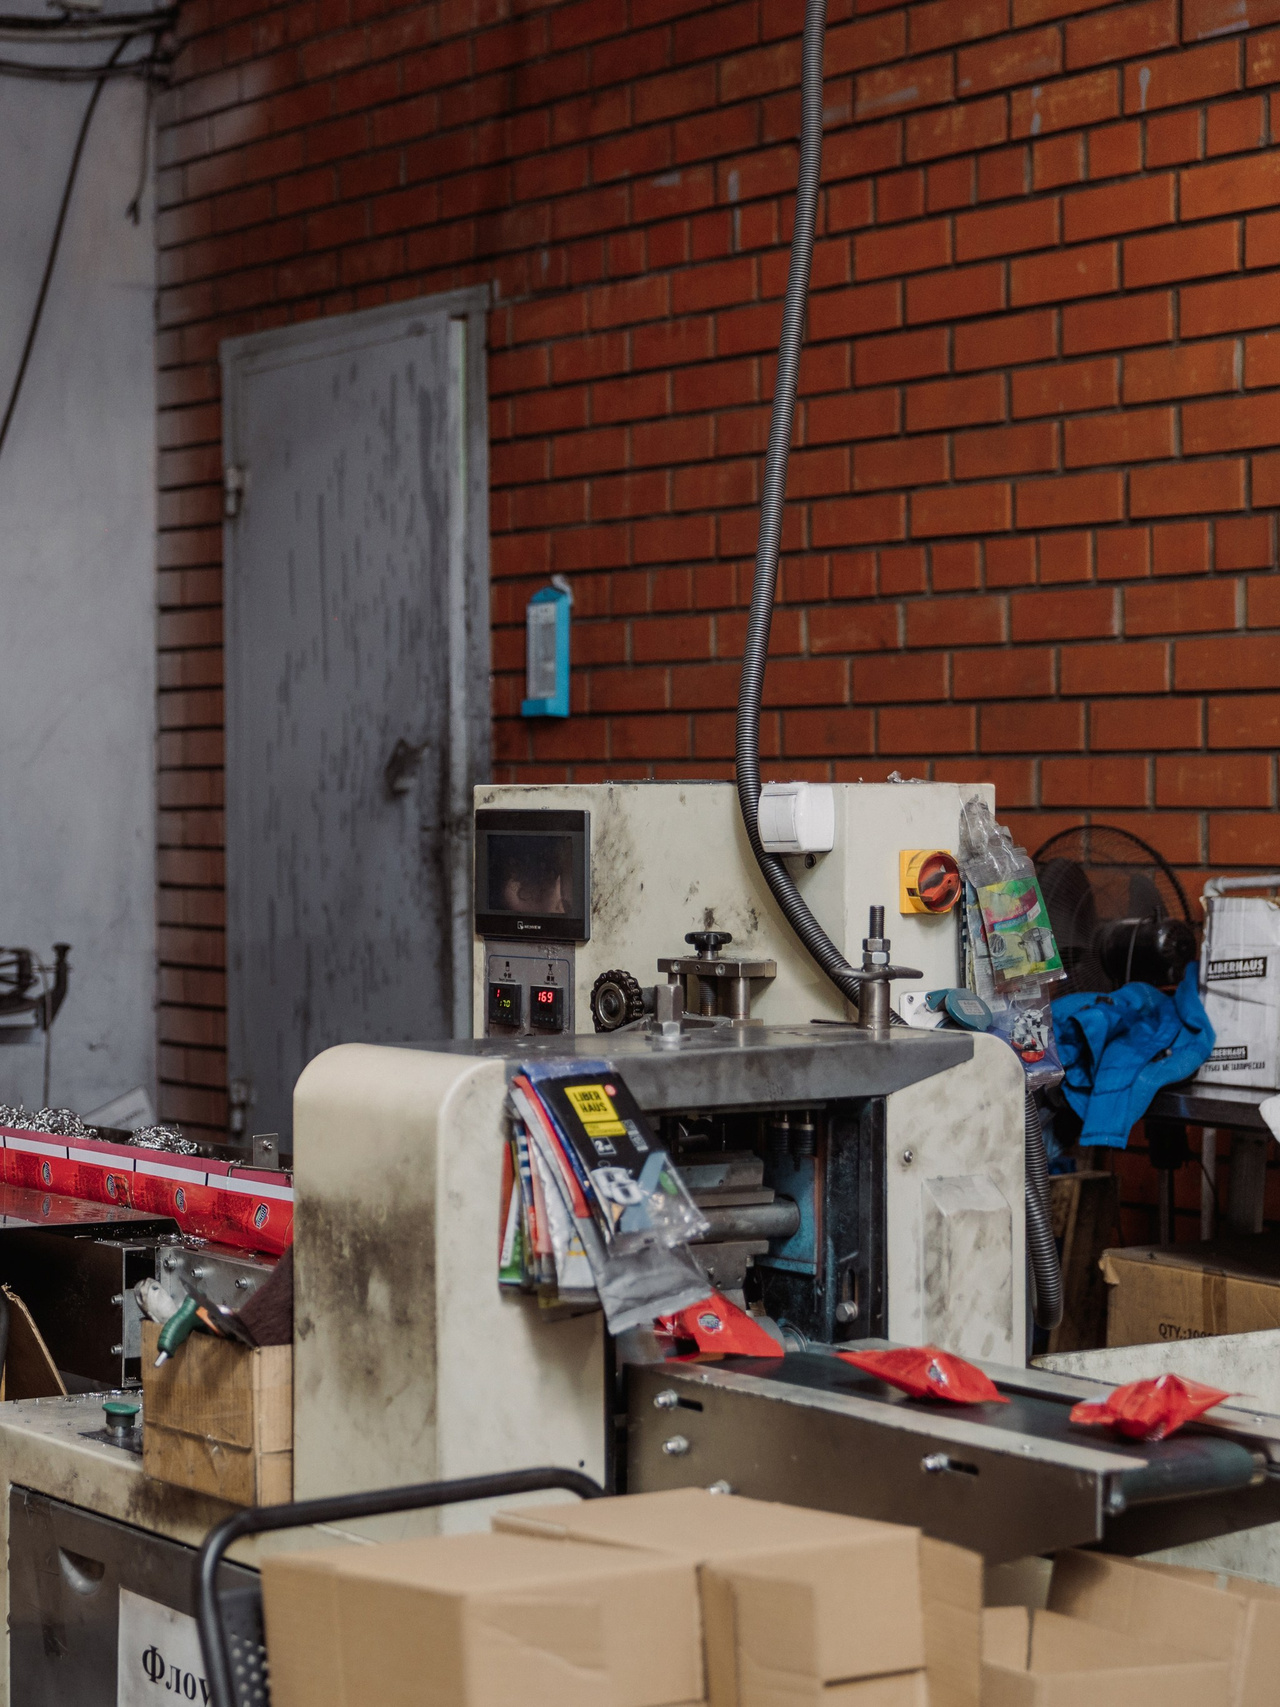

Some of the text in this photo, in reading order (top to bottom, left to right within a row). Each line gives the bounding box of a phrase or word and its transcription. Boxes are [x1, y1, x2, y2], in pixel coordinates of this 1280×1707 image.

[1208, 959, 1264, 974] LIBERHAUS
[537, 991, 554, 1004] 169
[573, 1091, 601, 1101] LIBER
[580, 1103, 607, 1112] HAUS
